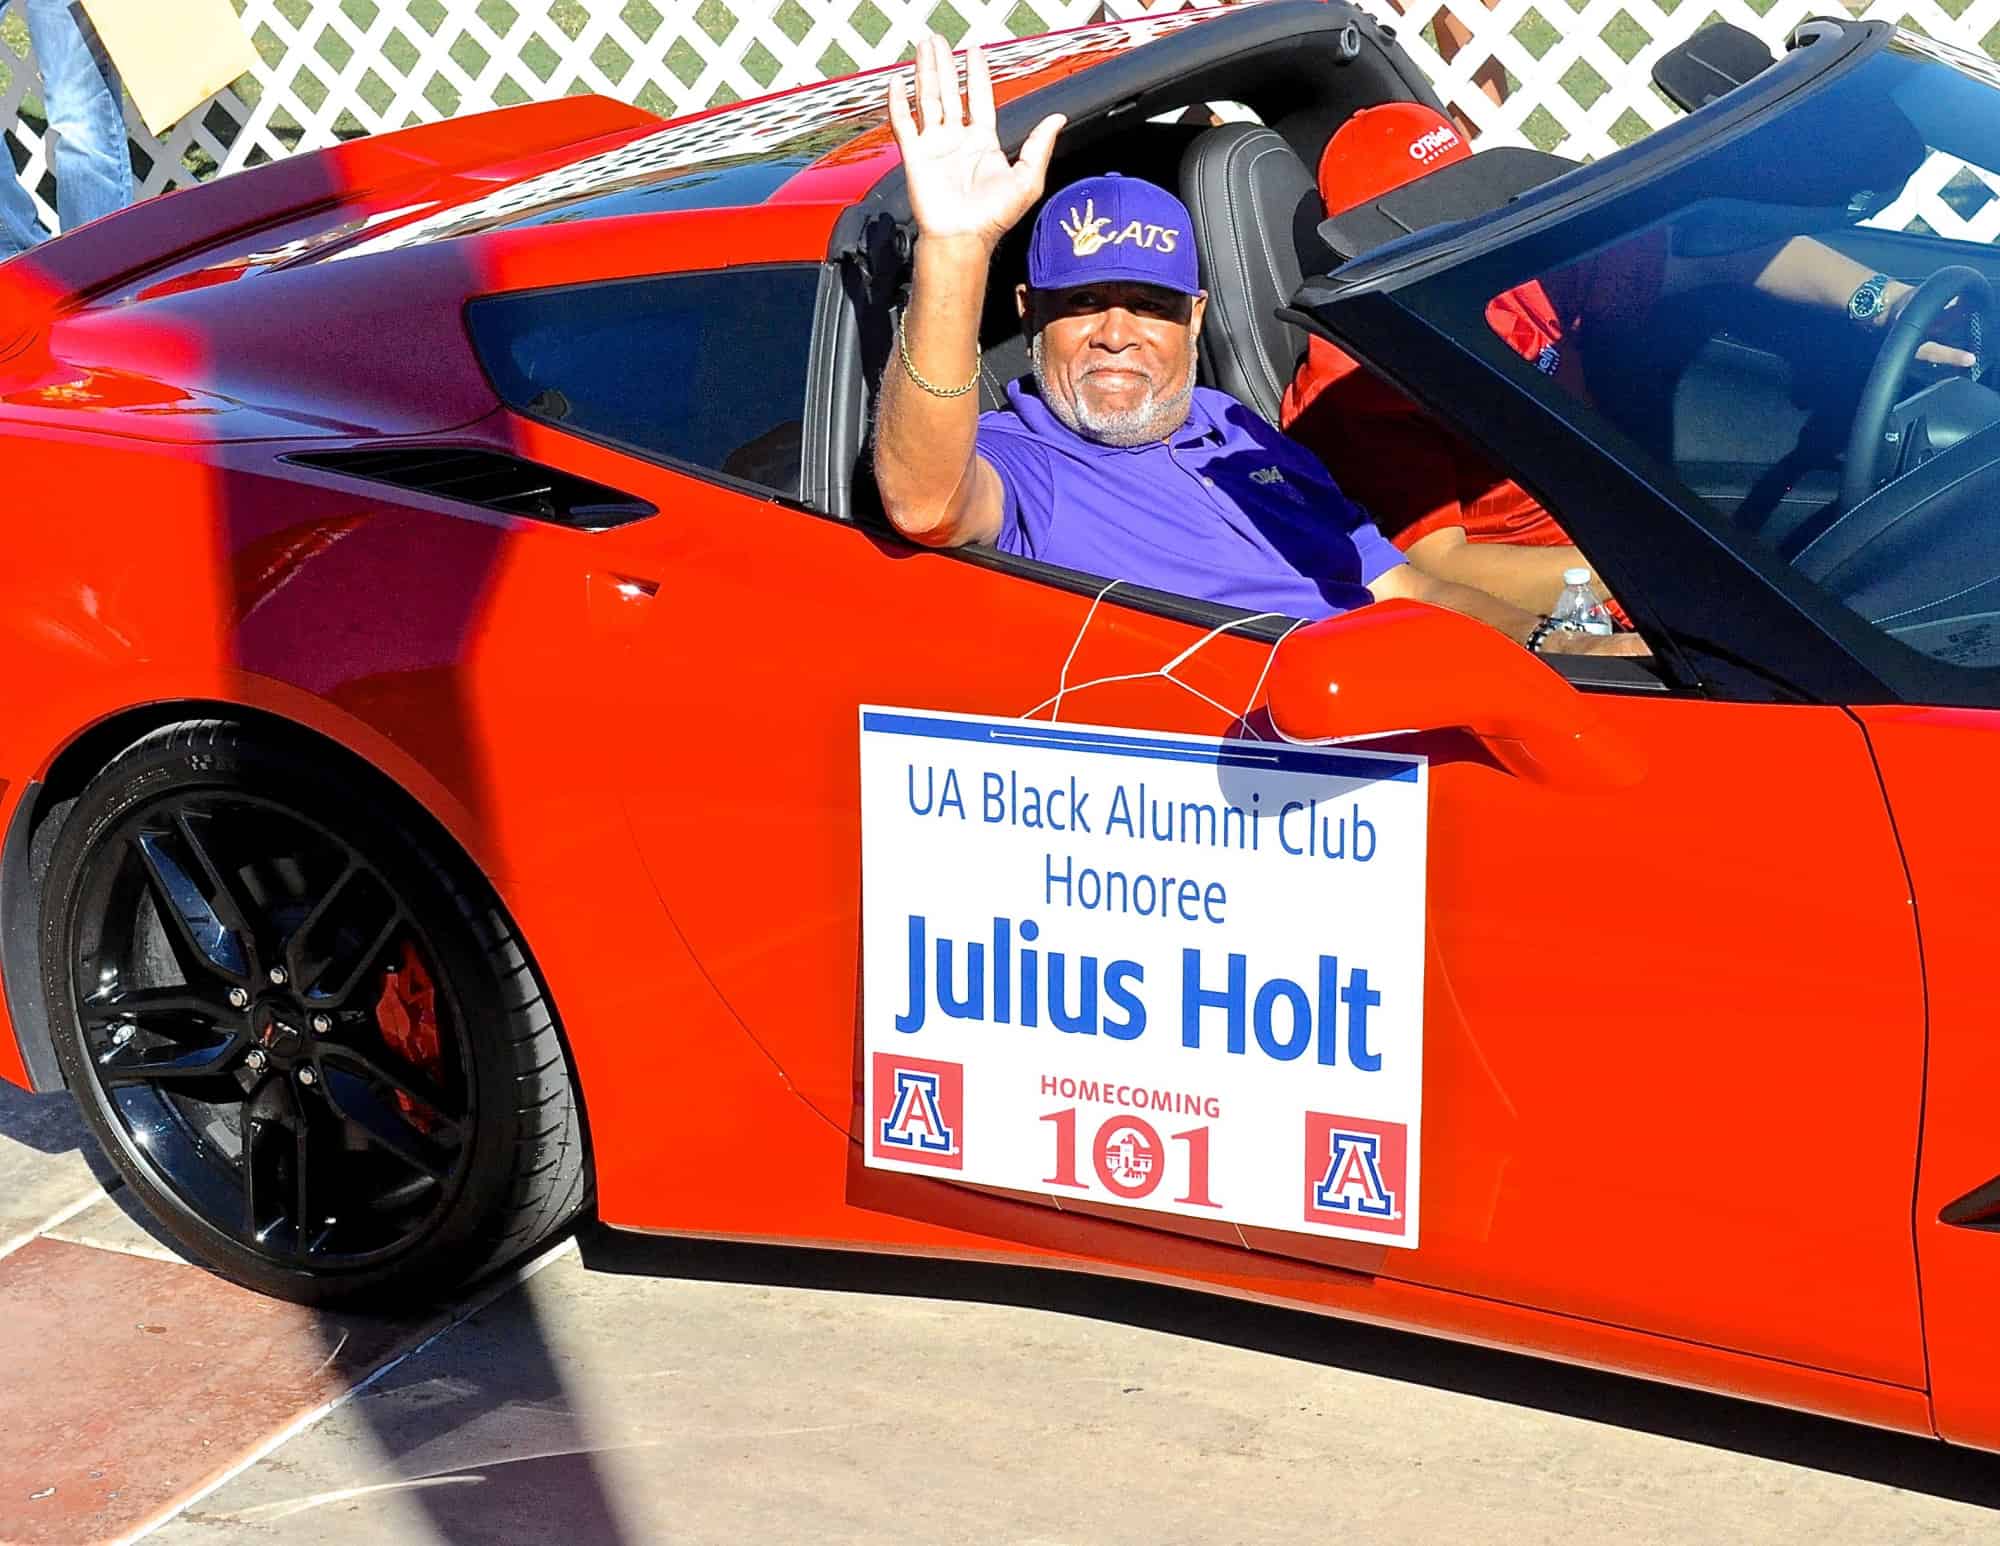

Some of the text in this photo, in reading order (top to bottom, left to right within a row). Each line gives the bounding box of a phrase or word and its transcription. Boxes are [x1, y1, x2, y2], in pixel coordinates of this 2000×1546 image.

[908, 764, 1377, 863] UA Black Alumni Club
[1045, 853, 1227, 924] Honoree
[895, 914, 1382, 1073] Julius Holt
[1040, 1074, 1221, 1120] HOMECOMING
[1039, 1107, 1223, 1209] 101
